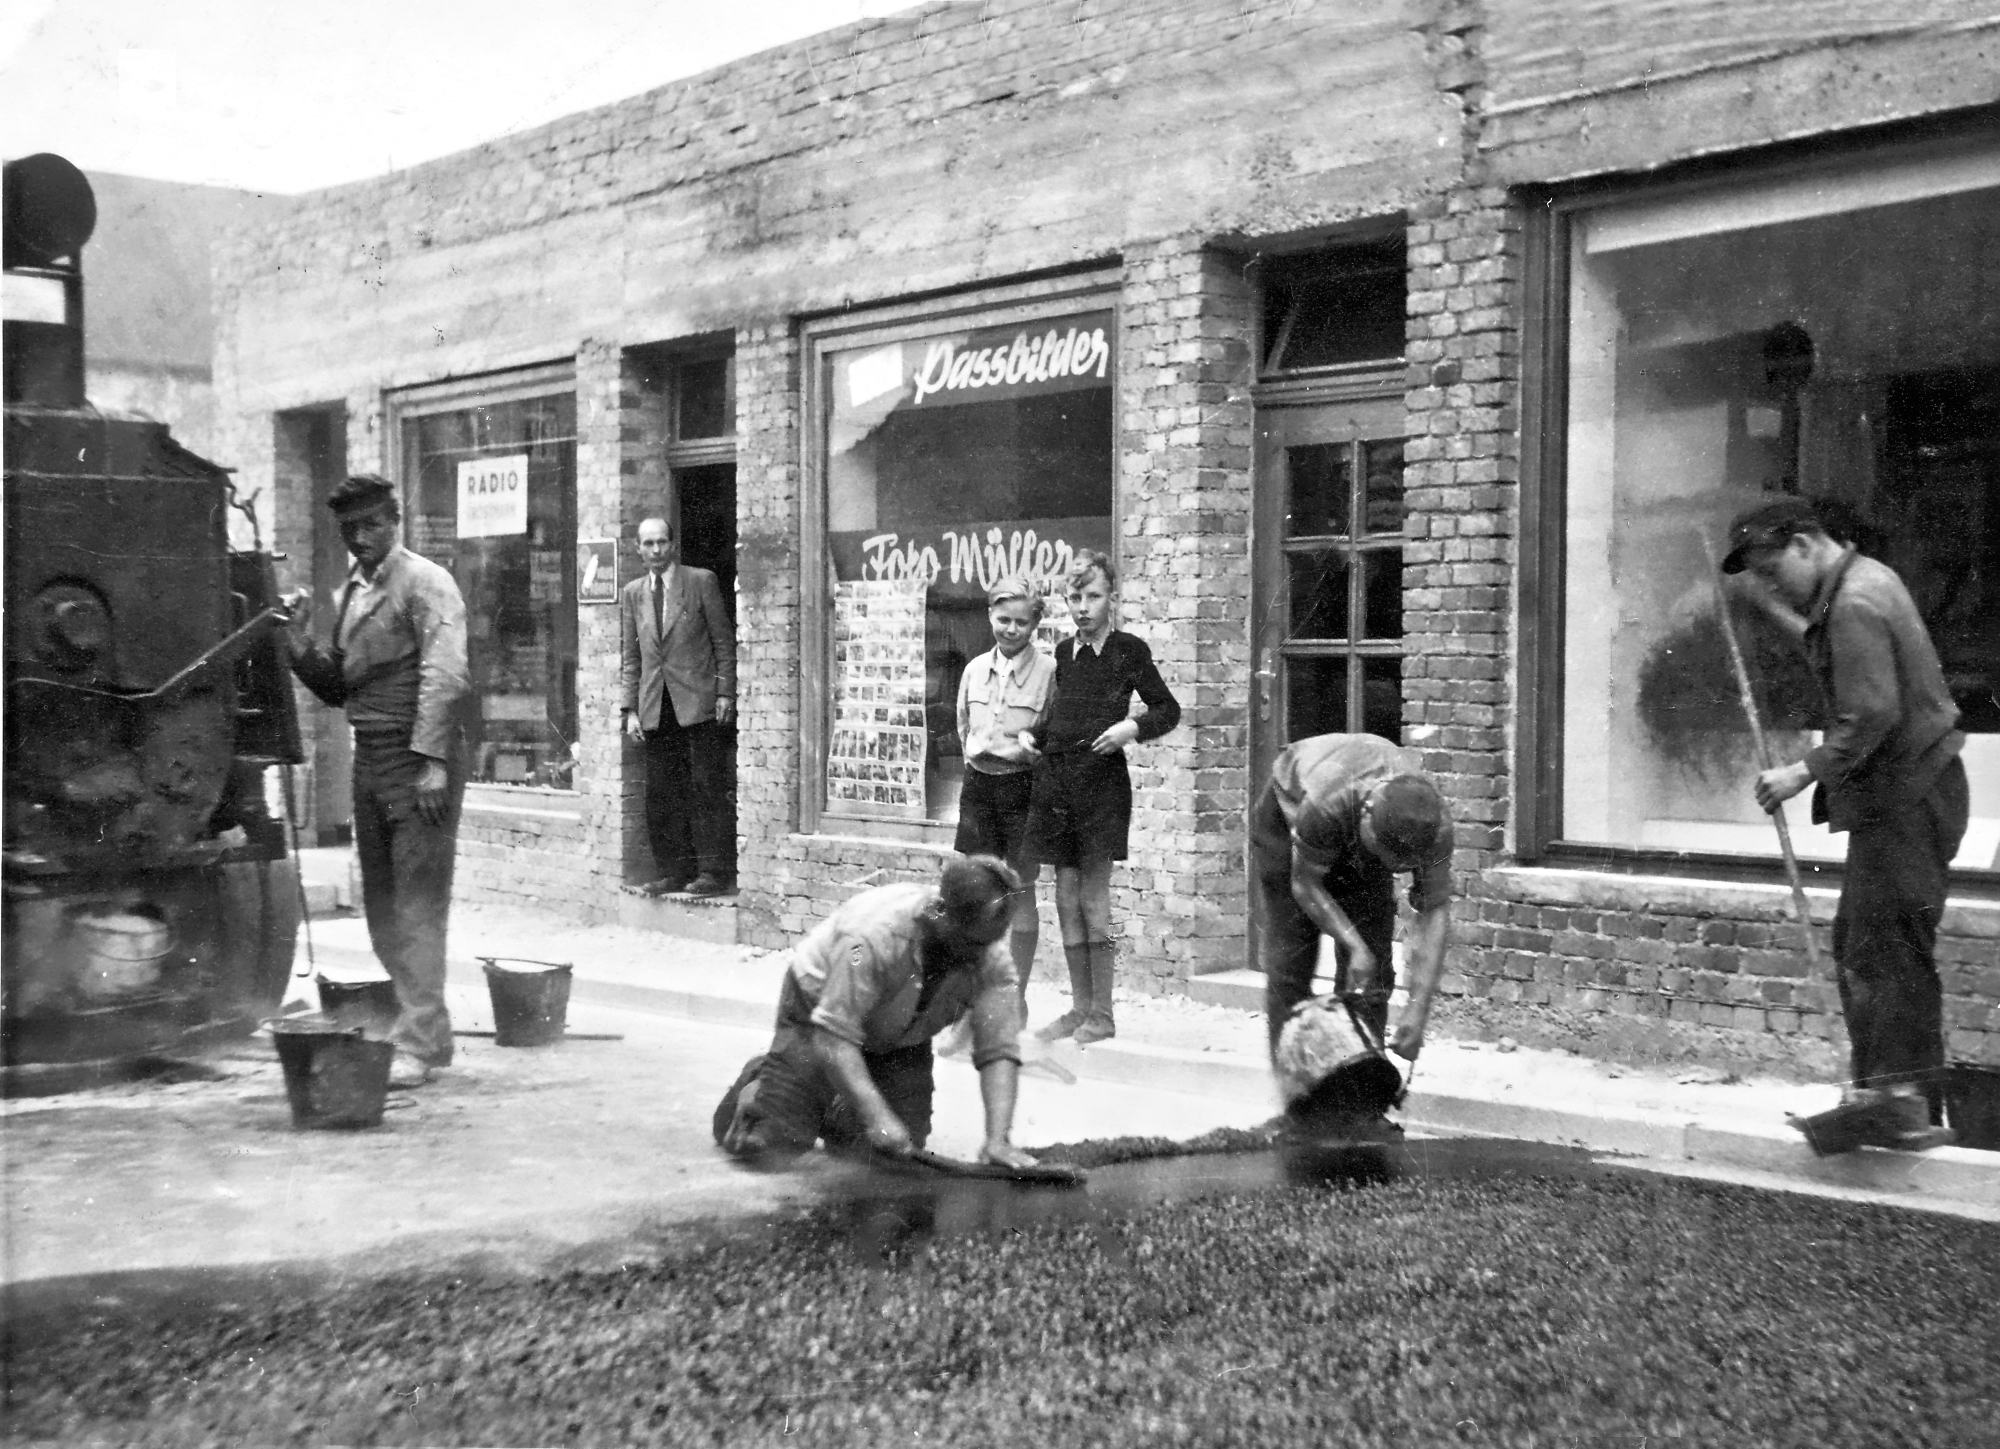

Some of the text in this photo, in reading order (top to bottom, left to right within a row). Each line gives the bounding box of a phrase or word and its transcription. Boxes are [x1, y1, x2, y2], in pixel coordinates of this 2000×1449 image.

[914, 328, 1110, 404] Passbilder
[468, 470, 518, 496] RADIO
[862, 527, 1074, 591] Foto Müller
